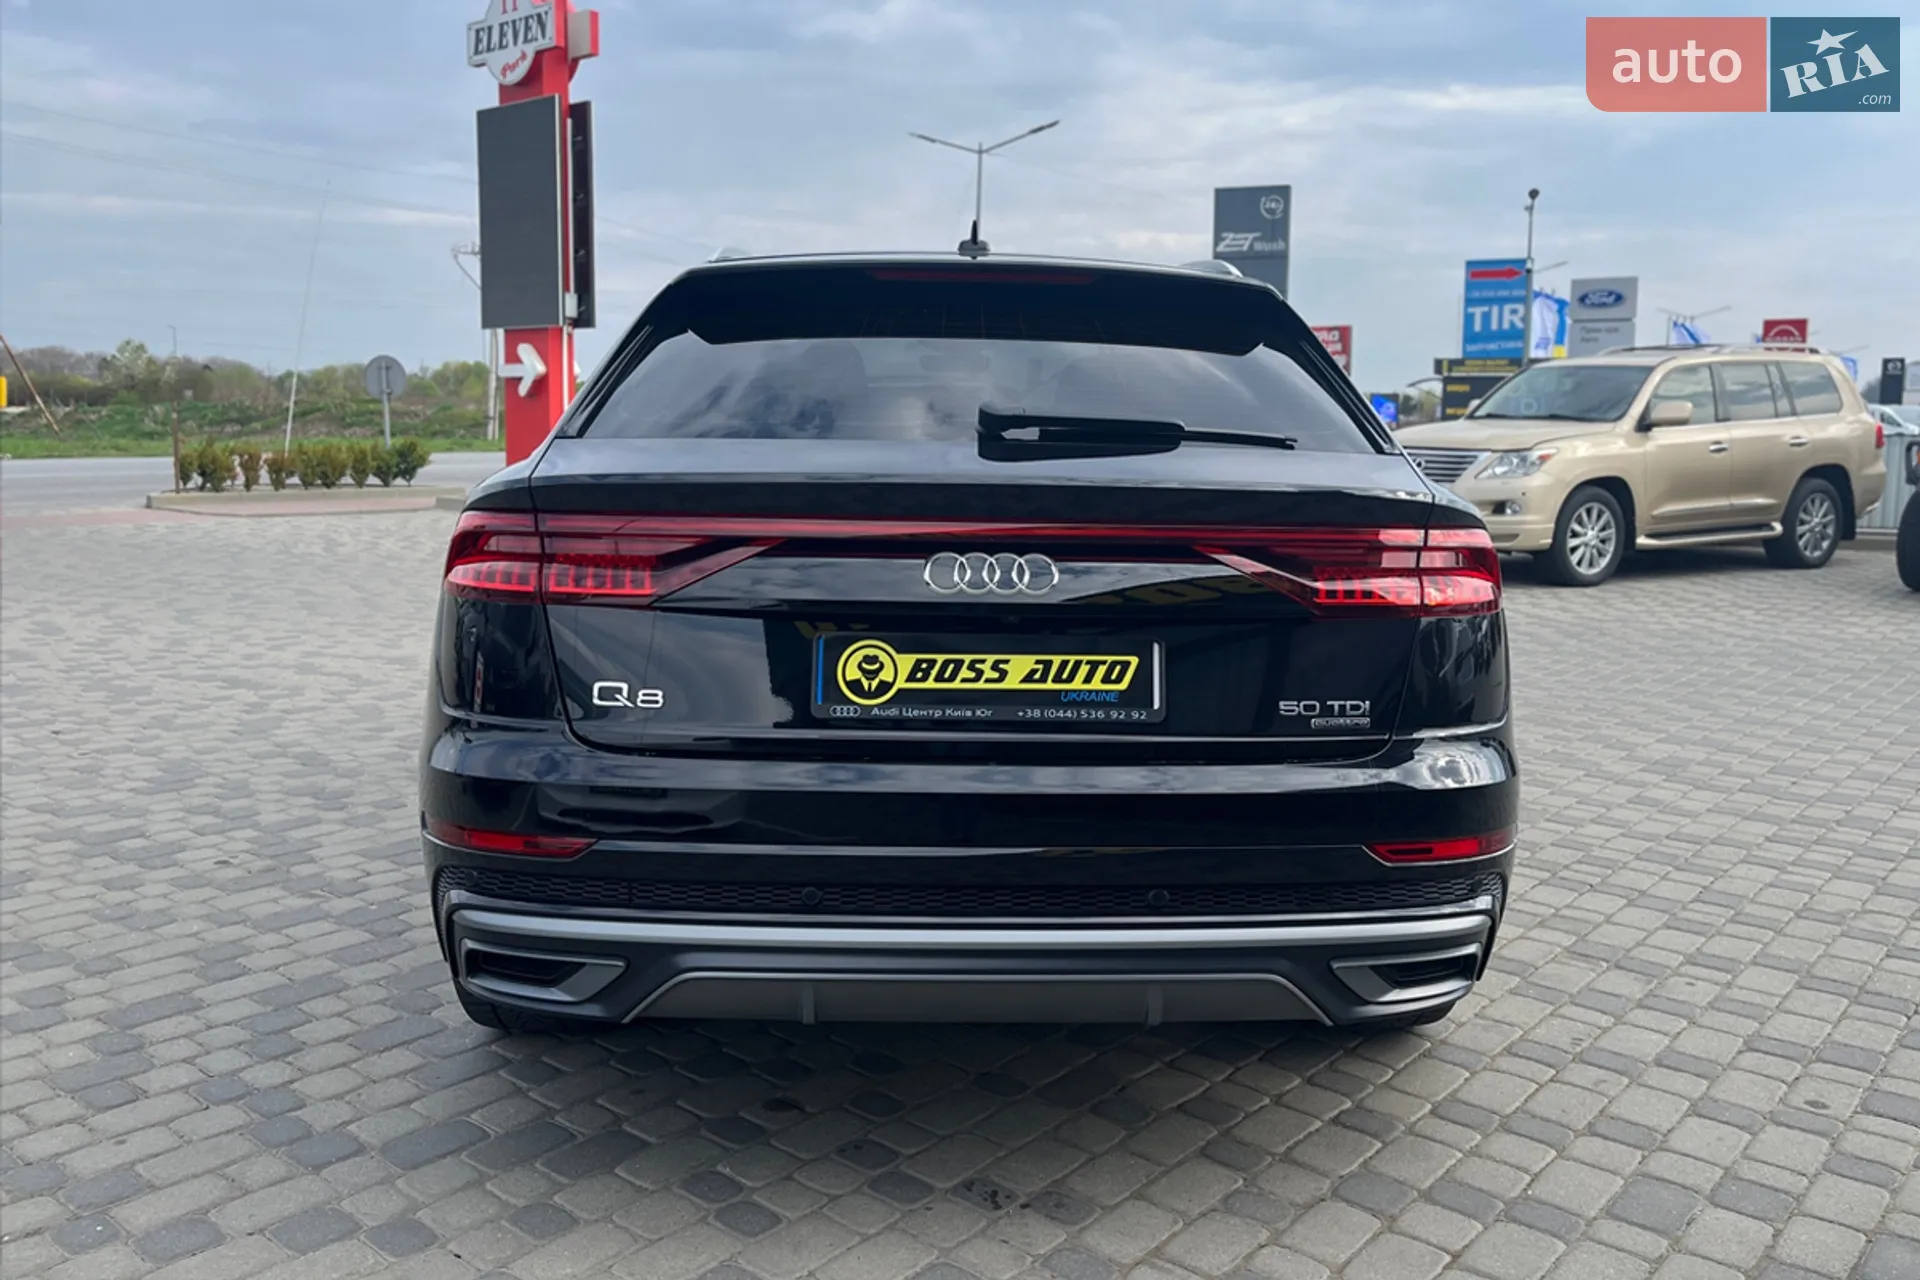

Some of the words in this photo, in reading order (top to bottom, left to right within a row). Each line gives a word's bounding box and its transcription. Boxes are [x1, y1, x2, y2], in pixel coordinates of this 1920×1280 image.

[473, 10, 549, 56] ELEVEN
[1467, 303, 1526, 333] TIR
[904, 657, 1012, 684] BOSS
[1018, 658, 1133, 685] AUTO
[592, 680, 664, 709] Q8
[1060, 691, 1120, 702] UKRAINE
[870, 707, 900, 717] Audi
[902, 707, 943, 719] Центр
[975, 708, 994, 717] Юг
[1016, 708, 1042, 719] +38
[1043, 708, 1078, 719] (044)
[1080, 709, 1106, 719] 536
[1109, 709, 1127, 720] 92
[1130, 709, 1148, 720] 92
[1278, 700, 1320, 716] 50
[1326, 700, 1371, 716] TDI
